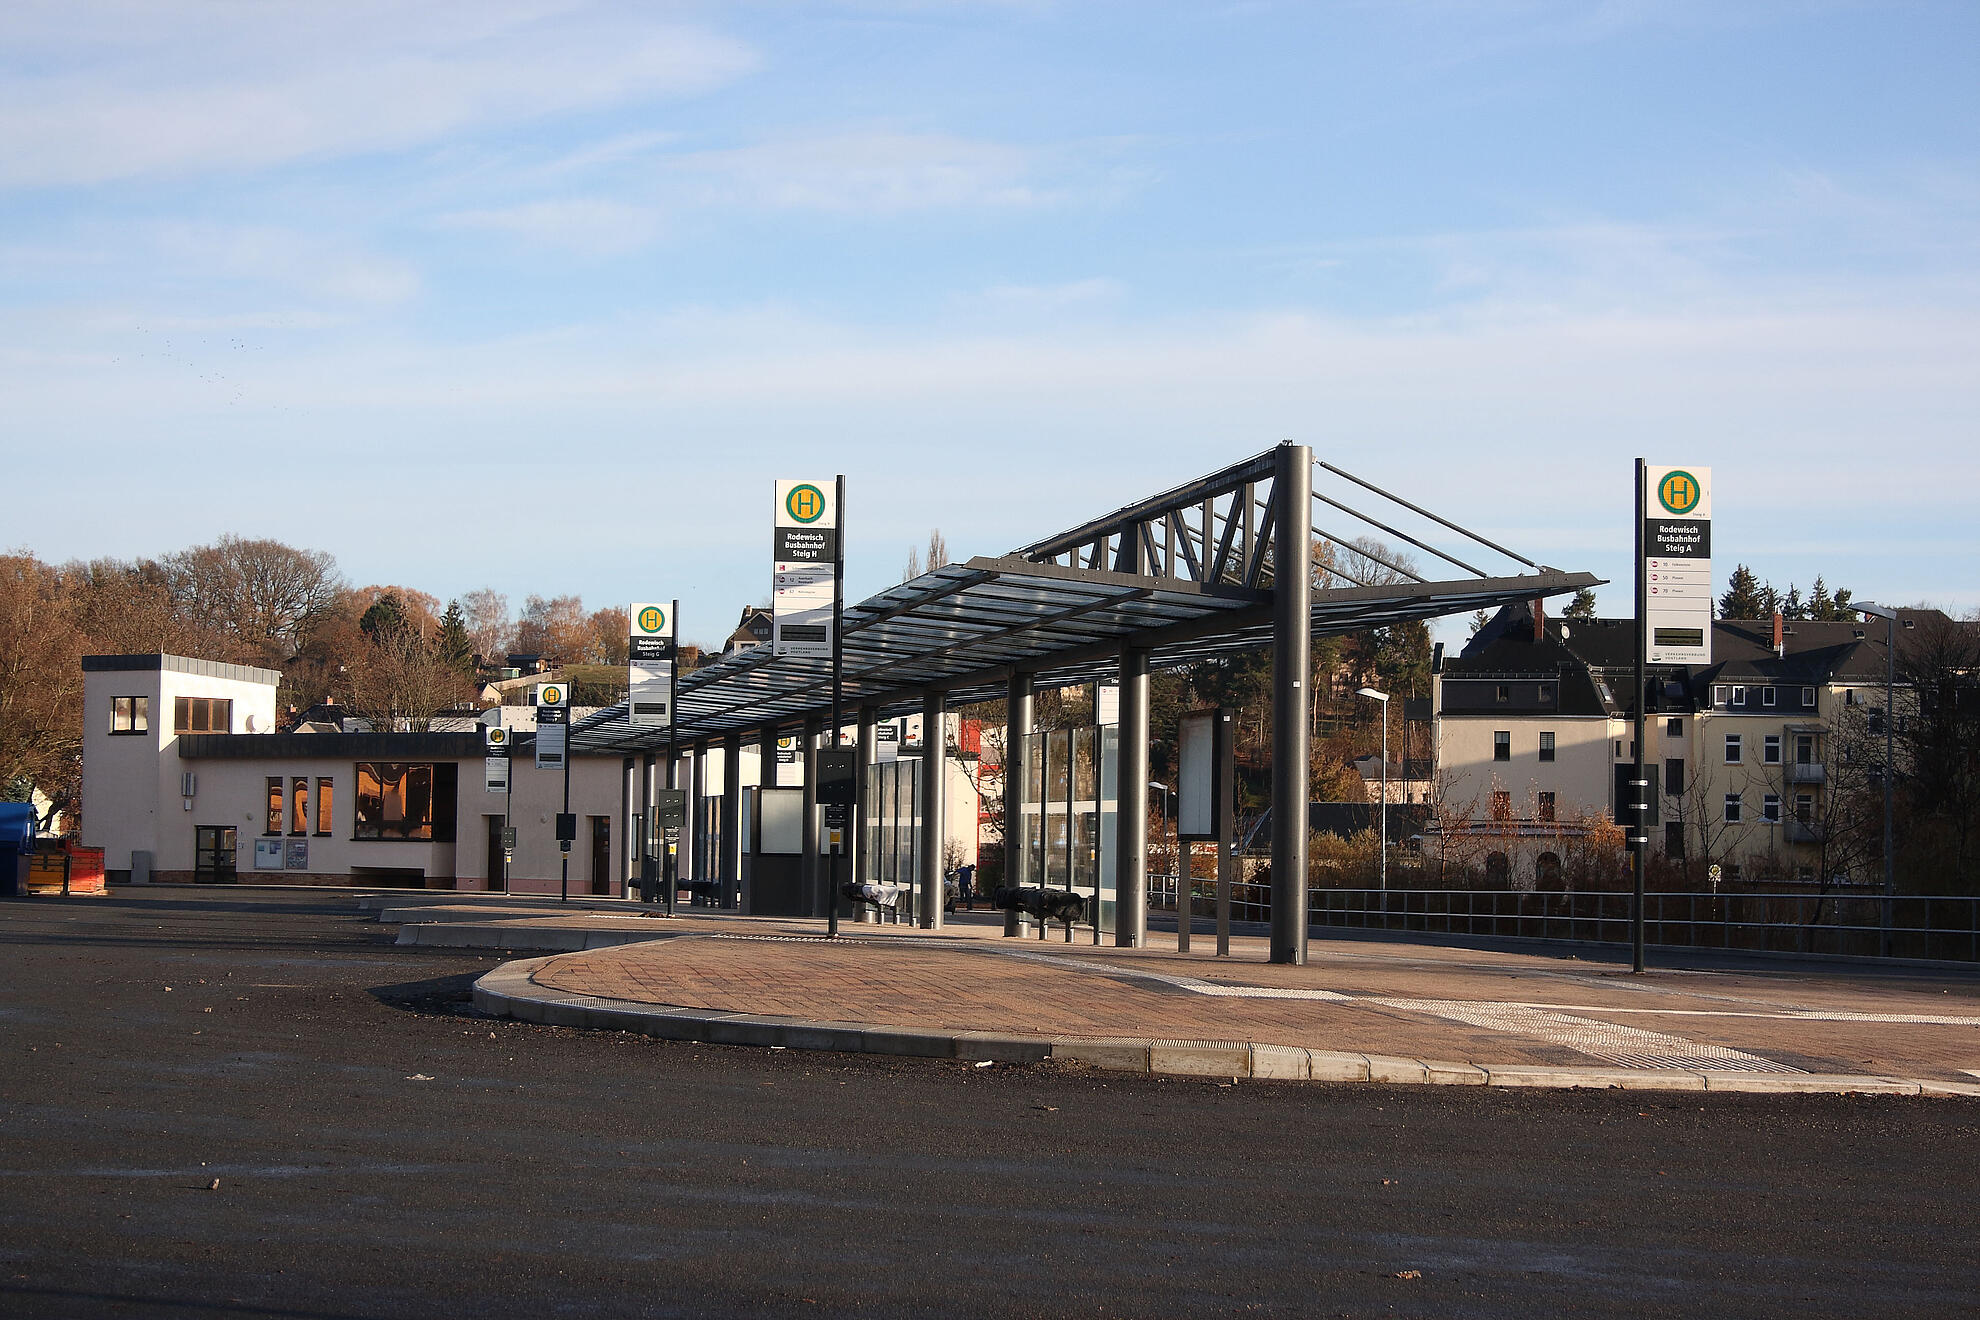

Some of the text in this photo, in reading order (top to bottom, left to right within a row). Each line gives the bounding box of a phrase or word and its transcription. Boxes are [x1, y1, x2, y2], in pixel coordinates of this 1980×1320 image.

[1670, 480, 1688, 505] H
[797, 492, 814, 515] H
[1659, 525, 1698, 534] Rodewisch
[787, 533, 824, 541] Rodewisch
[1657, 534, 1701, 543] Busbahnhof
[784, 541, 826, 549] Busbahnhof
[1665, 544, 1692, 553] Steig A
[792, 550, 811, 558] Steig
[646, 612, 657, 628] H
[548, 689, 557, 701] H
